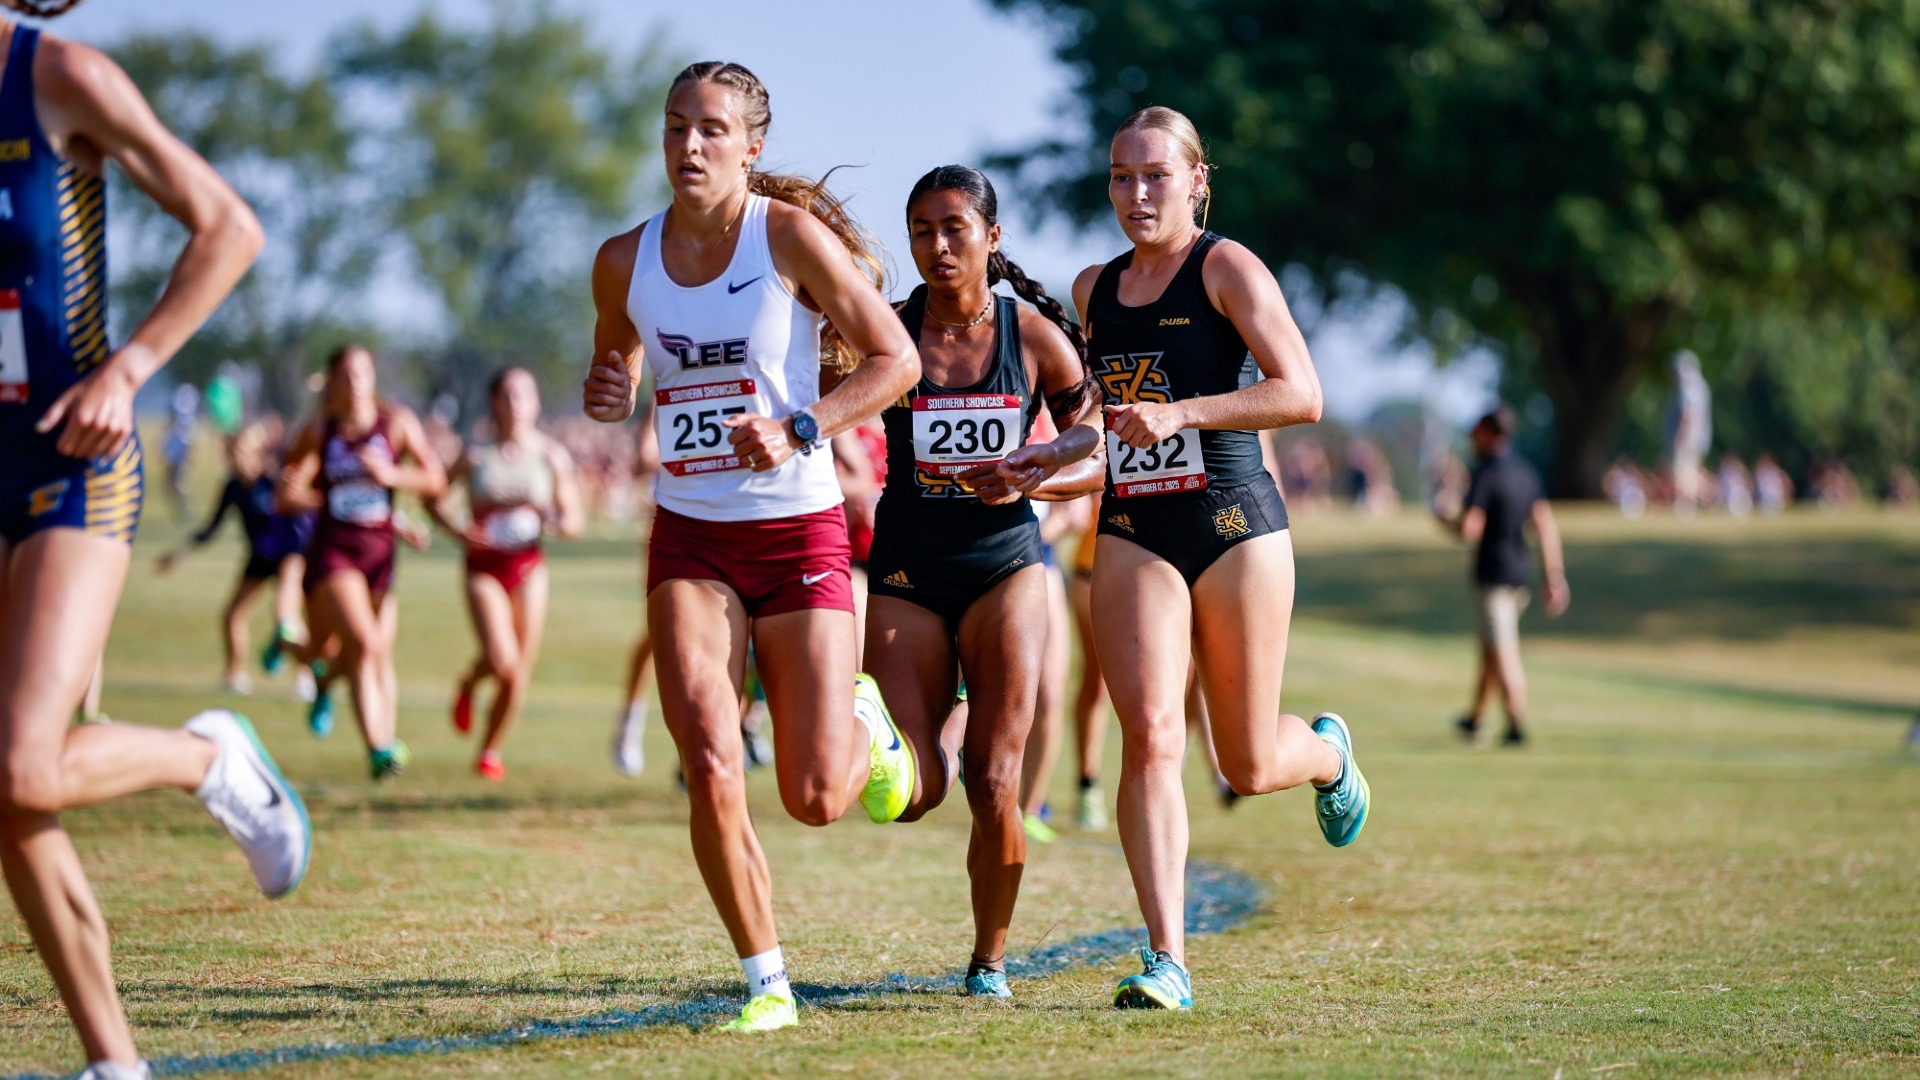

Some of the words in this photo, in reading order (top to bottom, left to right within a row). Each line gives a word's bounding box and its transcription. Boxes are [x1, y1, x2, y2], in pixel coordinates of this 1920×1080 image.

[677, 338, 749, 370] LEE
[669, 389, 703, 402] SOUTHERN
[704, 383, 743, 398] SHOWCASE
[927, 398, 965, 410] SOUTHERN
[965, 396, 1006, 408] SHOWCASE
[928, 418, 1005, 454] 230
[1117, 433, 1188, 474] 232
[684, 462, 717, 473] SEPTEMBER
[726, 457, 740, 467] 2025
[1127, 483, 1157, 494] SEPTEMBER
[1164, 480, 1180, 490] 2025
